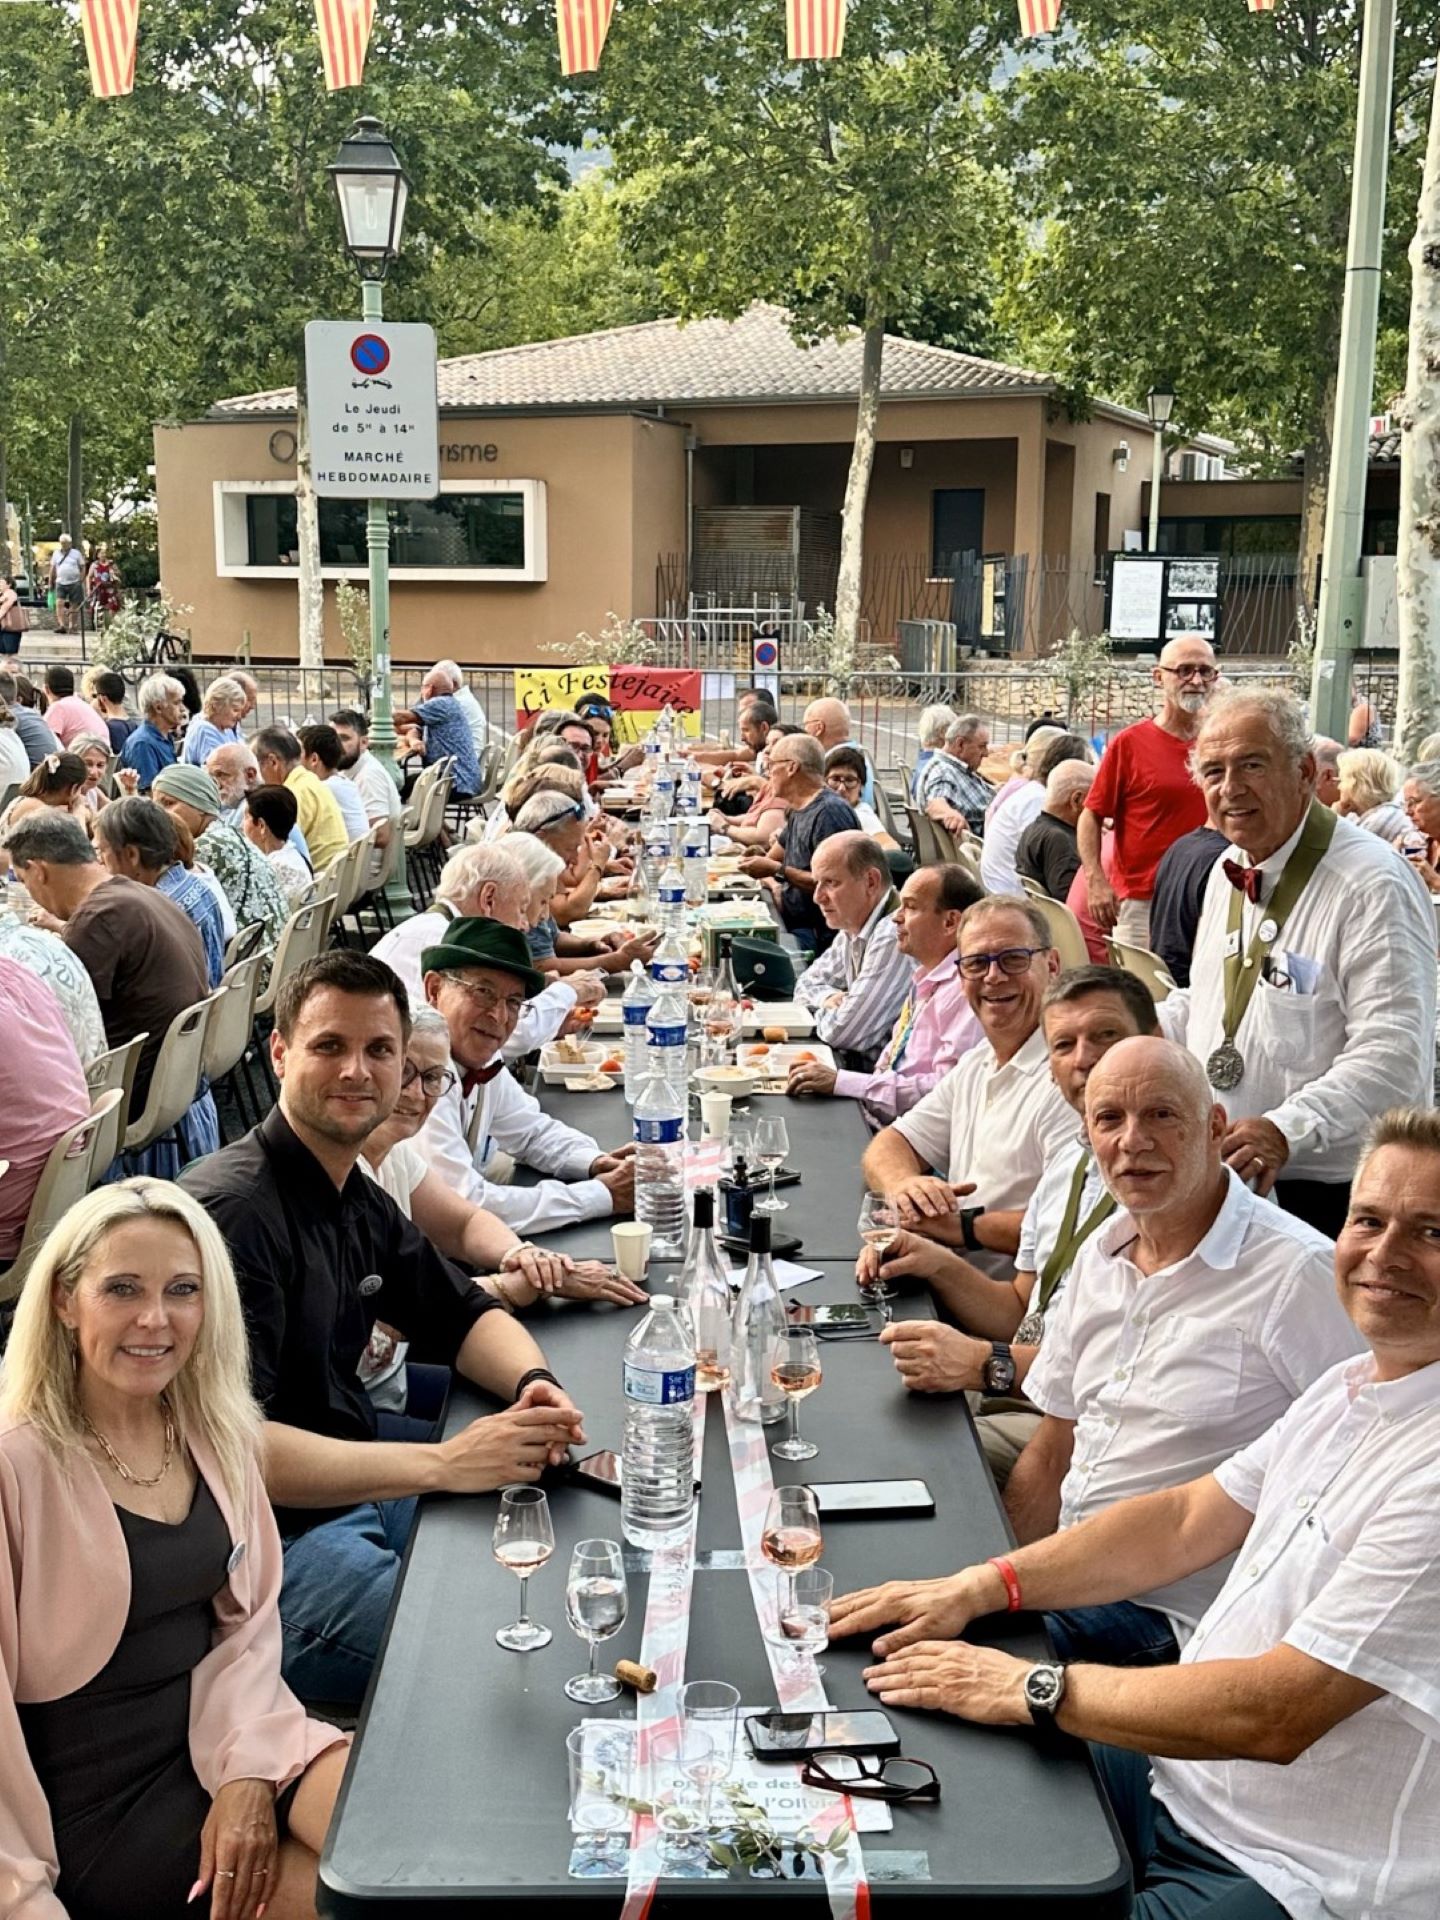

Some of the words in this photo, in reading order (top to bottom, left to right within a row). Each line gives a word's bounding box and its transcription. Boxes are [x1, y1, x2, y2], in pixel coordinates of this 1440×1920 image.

[344, 403, 360, 414] Le
[365, 403, 401, 414] Jeudi
[332, 422, 349, 433] de
[379, 423, 387, 433] à
[344, 450, 405, 462] MARCHÉ
[439, 443, 498, 463] risme
[317, 472, 432, 484] HEBDOMADAIRE
[765, 1779, 801, 1789] des
